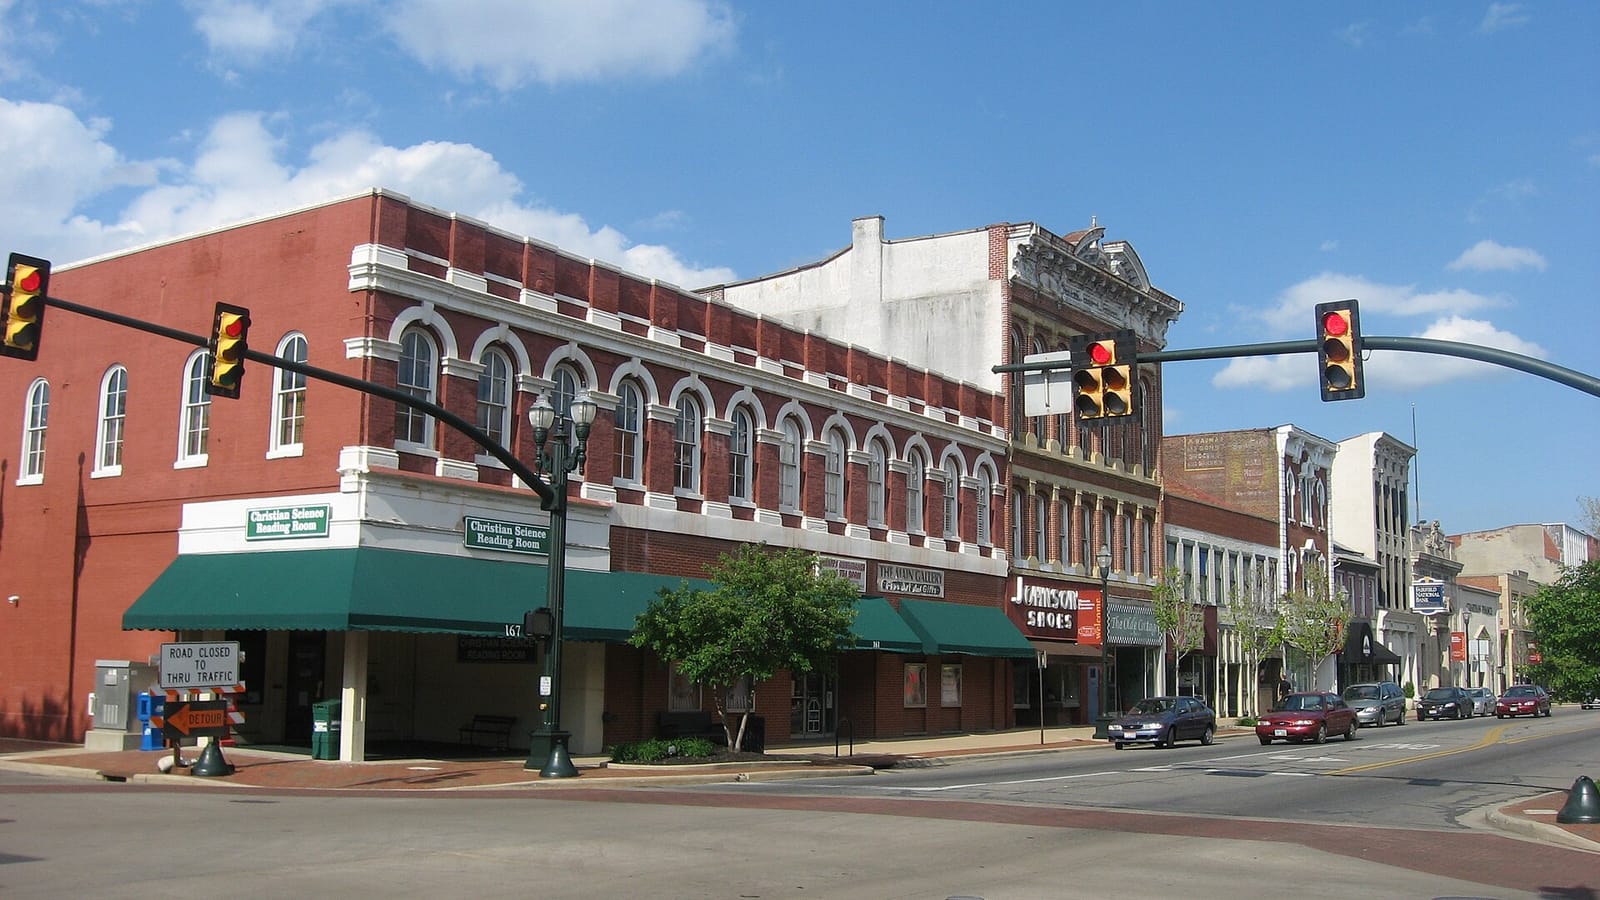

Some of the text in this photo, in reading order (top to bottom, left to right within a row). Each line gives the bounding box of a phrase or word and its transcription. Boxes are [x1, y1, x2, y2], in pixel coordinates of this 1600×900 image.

[250, 508, 324, 522] Christian Science
[256, 520, 317, 534] Reading Room
[470, 520, 547, 539] Christian Science
[477, 532, 540, 549] Reading Room
[880, 565, 893, 578] THE
[915, 570, 942, 585] GALLERY
[1010, 576, 1078, 610] JOHNSON
[1026, 610, 1073, 630] SHOES
[1093, 597, 1102, 640] welcome
[505, 624, 521, 637] 167
[169, 647, 230, 658] ROAD CLOSED
[195, 659, 206, 670] TO
[167, 671, 233, 683] THRU TRAFFIC
[189, 713, 222, 725] DETOUR
